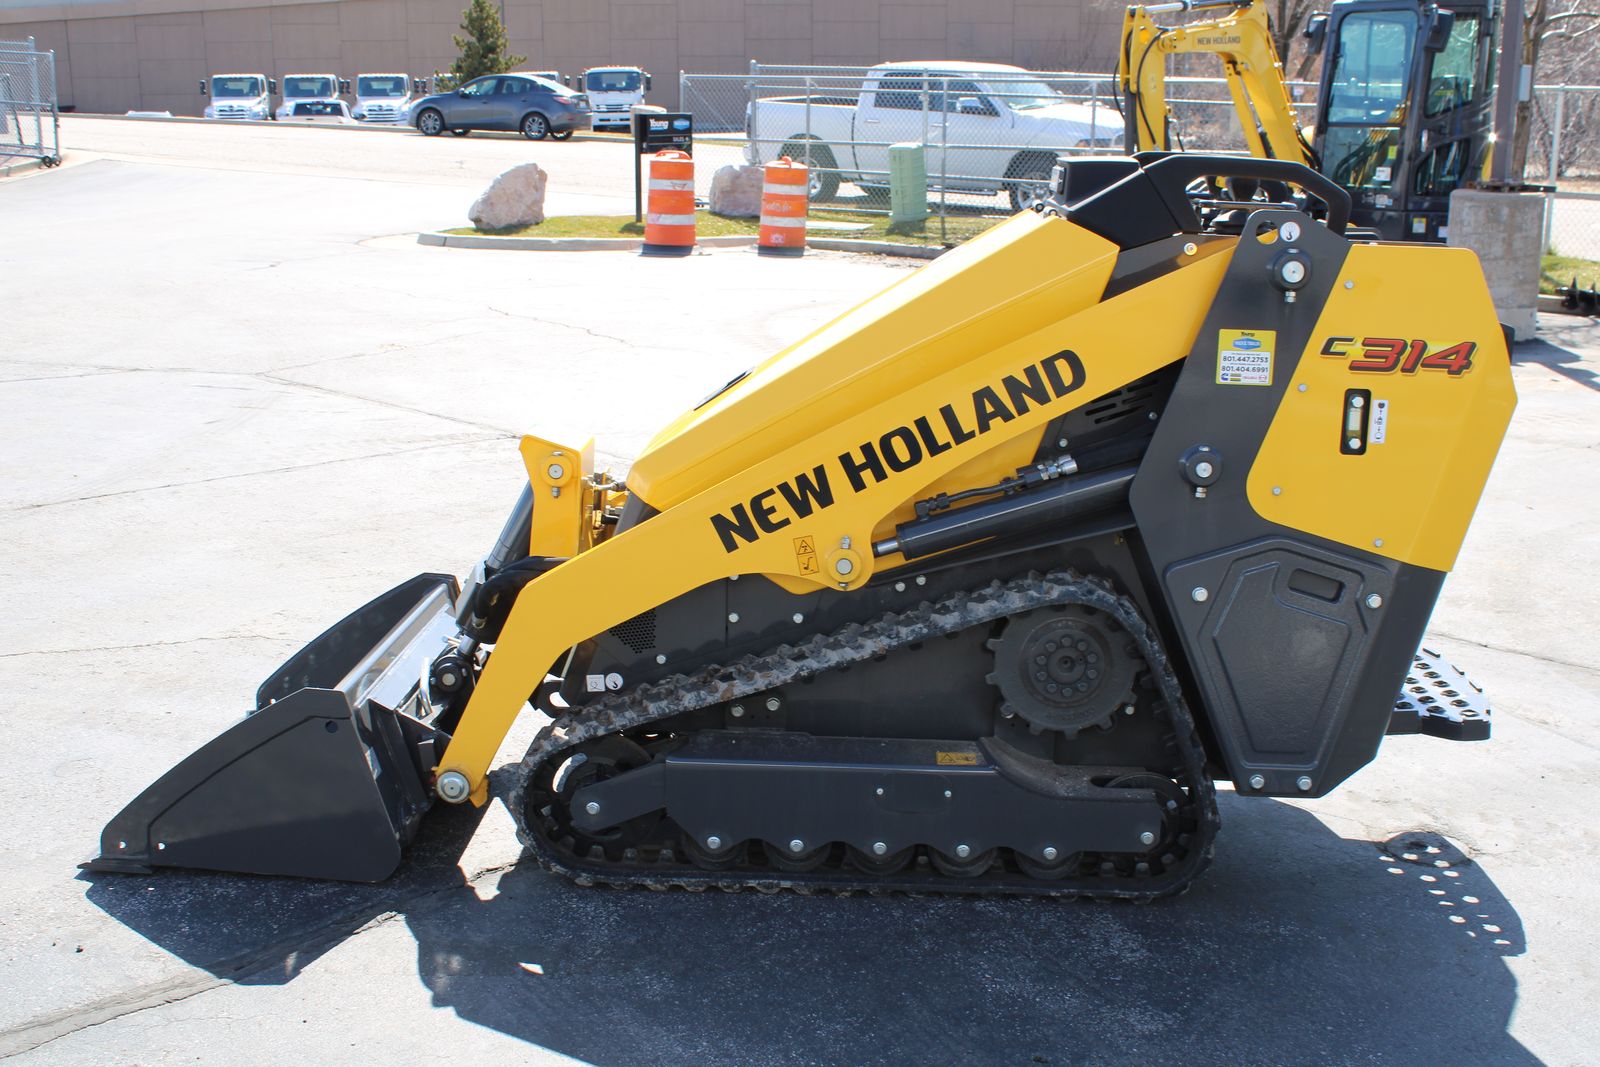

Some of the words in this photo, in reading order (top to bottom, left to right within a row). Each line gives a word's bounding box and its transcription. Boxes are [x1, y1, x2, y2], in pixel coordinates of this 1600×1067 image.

[1197, 37, 1212, 46] NEW
[1213, 35, 1241, 45] HOLLAND
[709, 463, 835, 553] NEW
[838, 349, 1087, 493] HOLLAND
